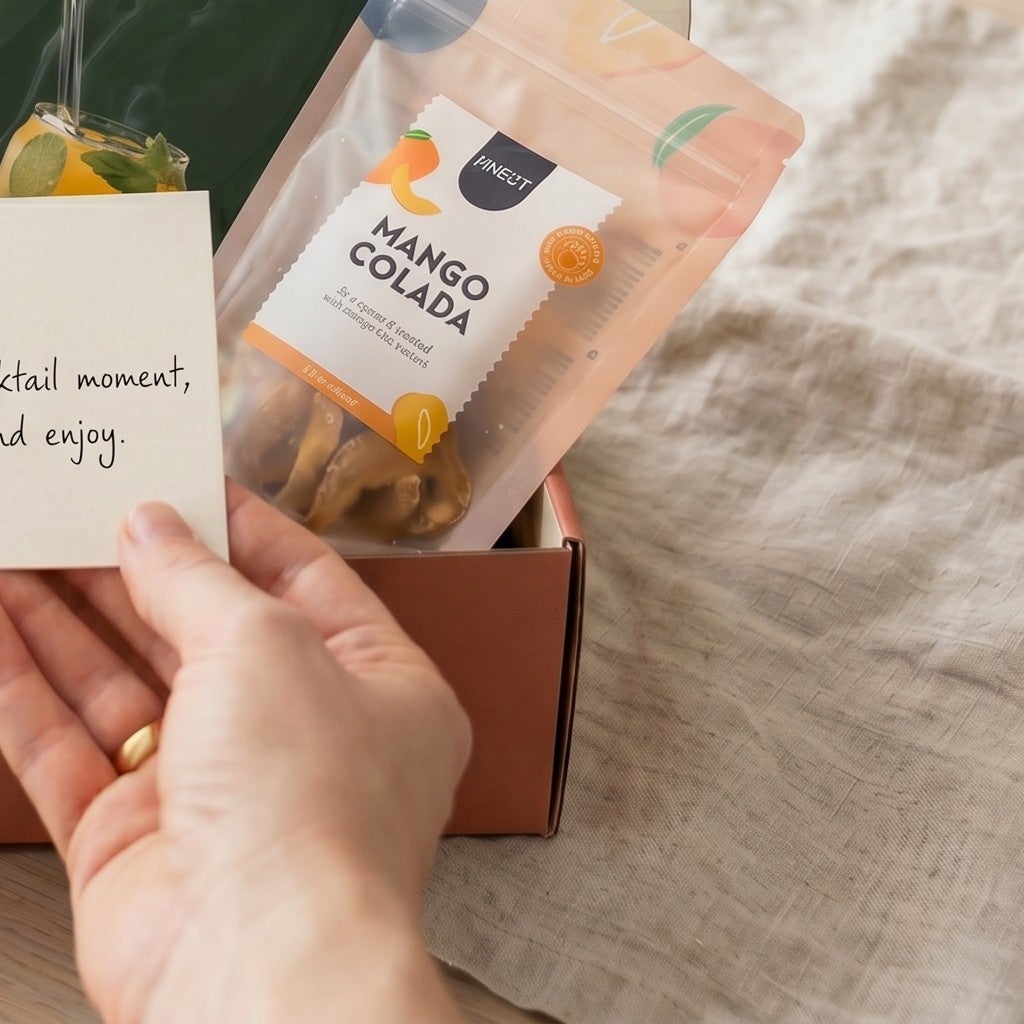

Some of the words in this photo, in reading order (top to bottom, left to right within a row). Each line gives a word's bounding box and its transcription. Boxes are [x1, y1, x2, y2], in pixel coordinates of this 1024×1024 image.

[349, 241, 472, 336] COLADA
[370, 215, 490, 301] MANGO
[77, 355, 191, 394] moment,
[45, 420, 126, 469] enjoy.
